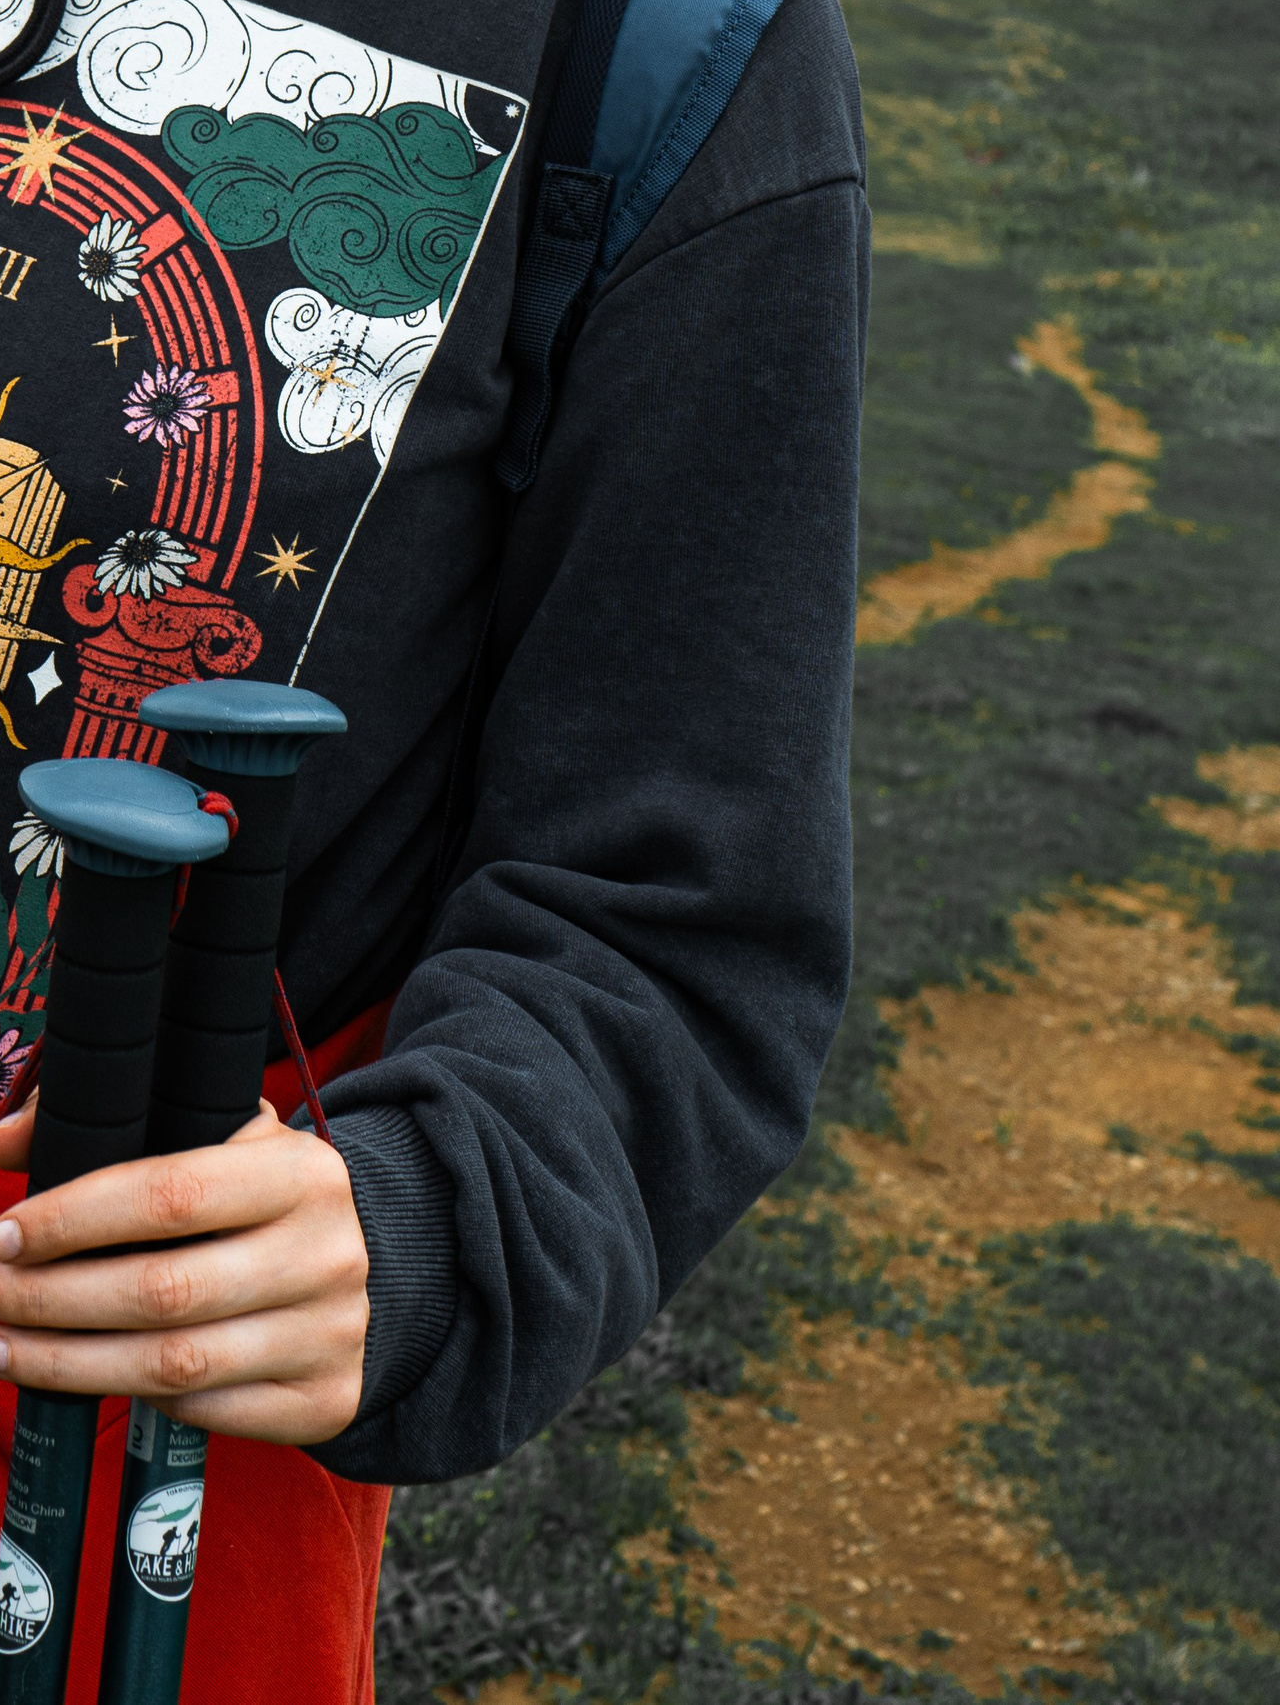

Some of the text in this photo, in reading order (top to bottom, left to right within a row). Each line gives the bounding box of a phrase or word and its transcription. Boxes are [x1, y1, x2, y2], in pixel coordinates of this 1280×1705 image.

[18, 1424, 56, 1447] 2022/11
[31, 1503, 66, 1518] China
[133, 1551, 173, 1577] TAKE
[175, 1559, 183, 1577] &
[0, 1609, 36, 1641] HIKE
